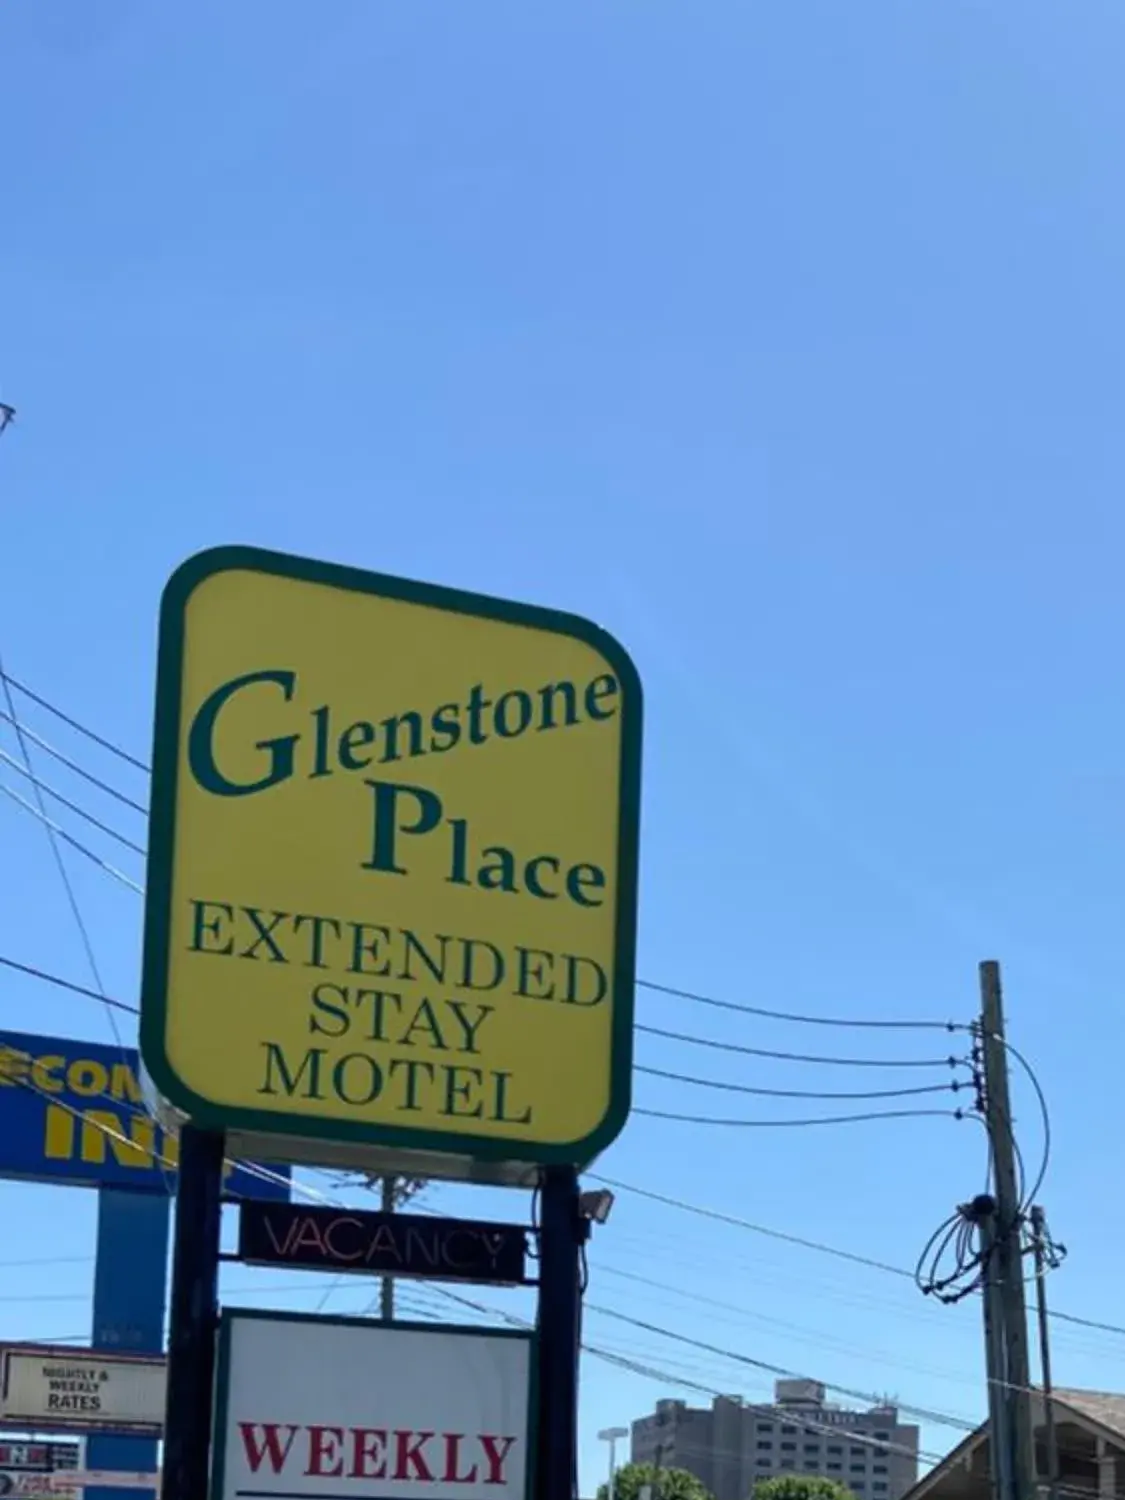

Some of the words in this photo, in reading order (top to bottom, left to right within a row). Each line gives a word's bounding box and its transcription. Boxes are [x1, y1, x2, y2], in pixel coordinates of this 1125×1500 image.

[187, 668, 620, 797] Glenstone
[360, 777, 607, 908] Place
[187, 898, 609, 1007] EXTENDED
[309, 983, 496, 1055] STAY
[257, 1041, 533, 1126] MOTEL
[263, 1215, 506, 1270] VACANCY
[48, 1393, 101, 1410] RATES
[49, 1380, 99, 1393] WEEKLY
[236, 1421, 518, 1486] WEEKLY
